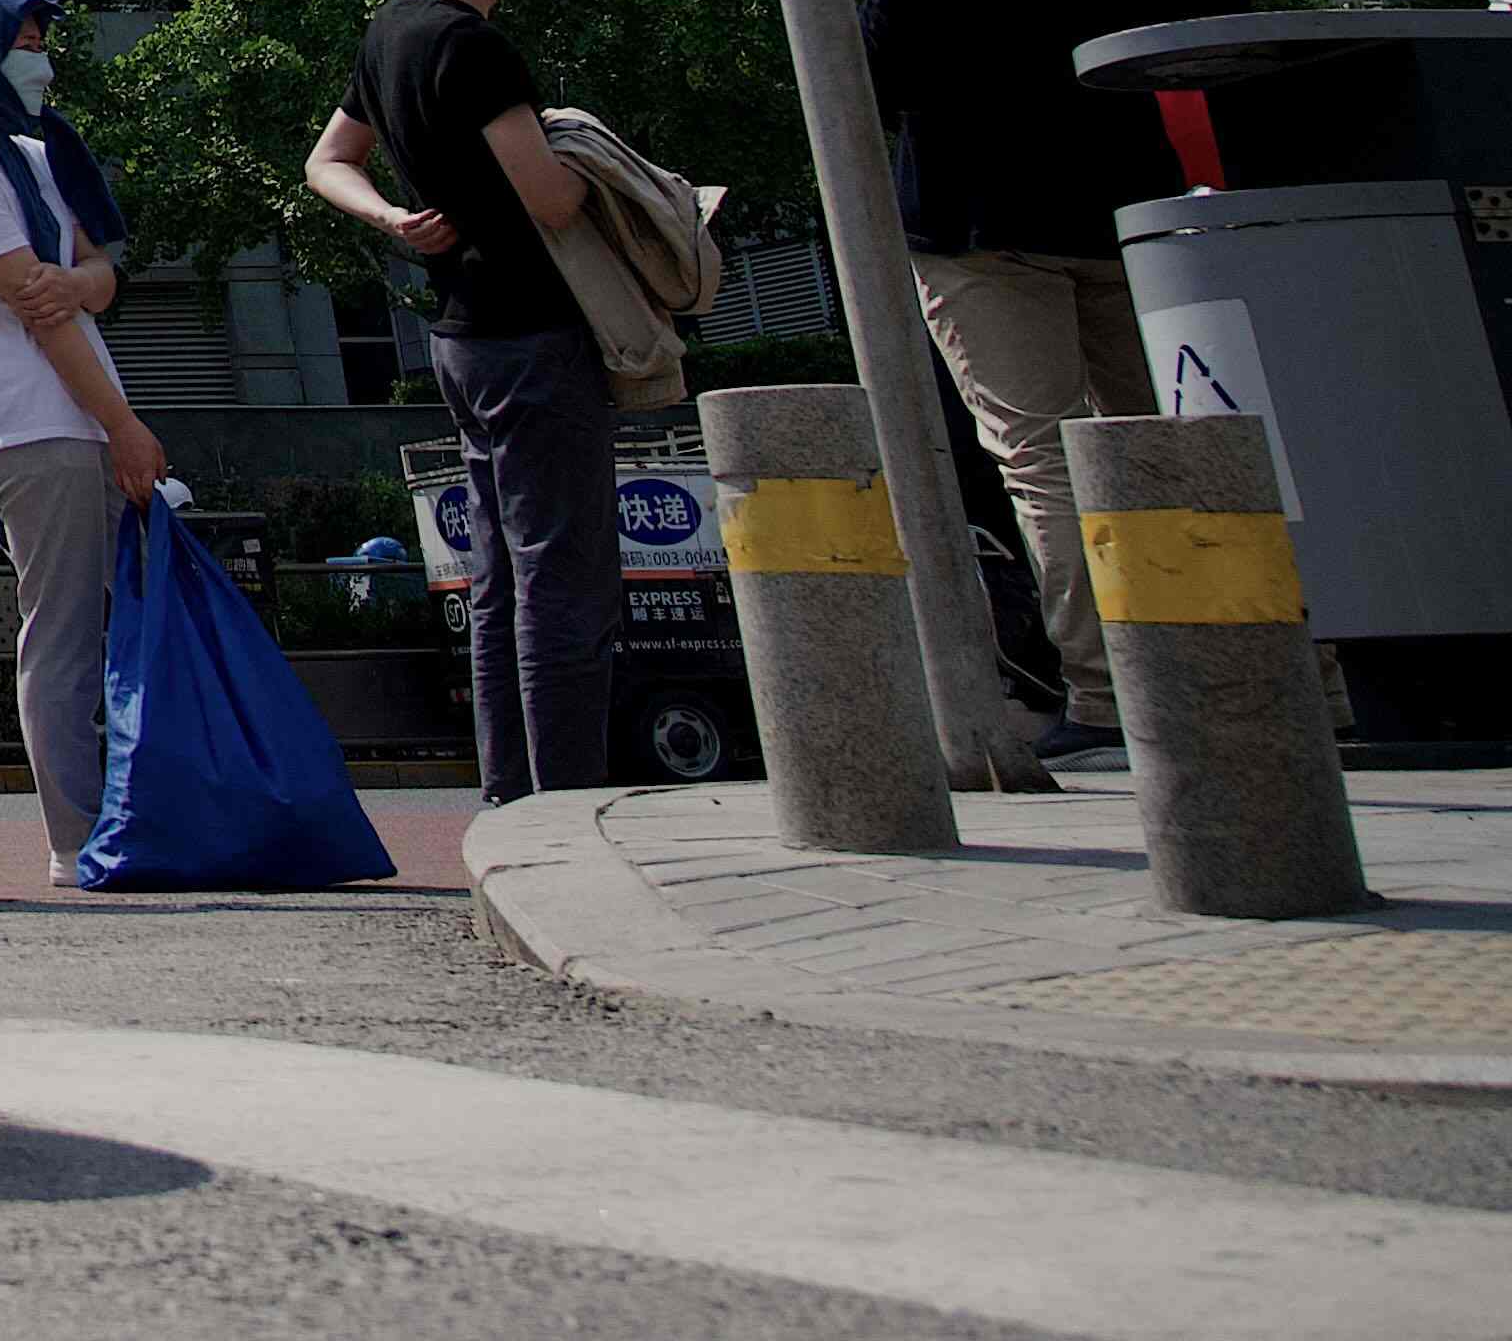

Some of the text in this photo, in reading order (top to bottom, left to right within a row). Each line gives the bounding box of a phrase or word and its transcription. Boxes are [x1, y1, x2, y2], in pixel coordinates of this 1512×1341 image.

[618, 492, 692, 533] 快递
[629, 591, 703, 607] EXPRESS
[628, 637, 743, 652] www.sf-express.co
